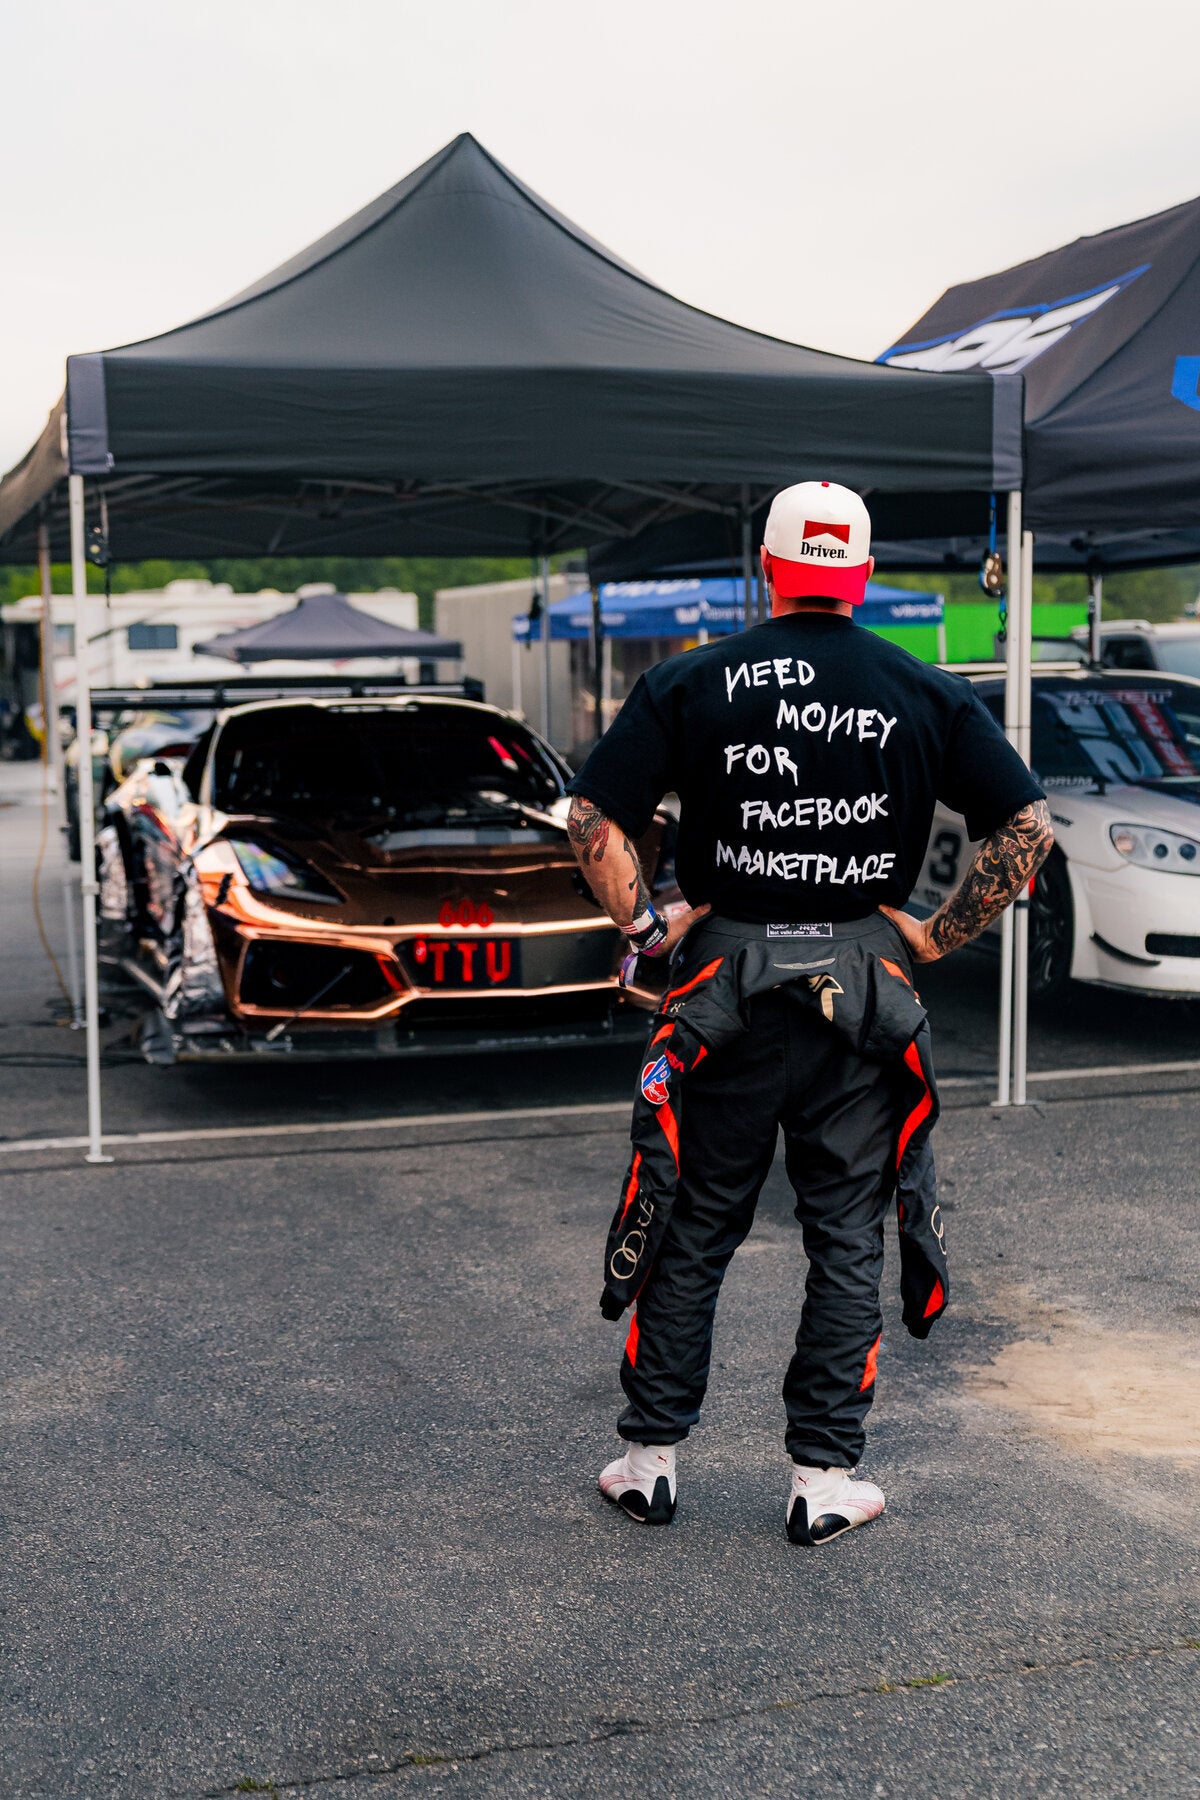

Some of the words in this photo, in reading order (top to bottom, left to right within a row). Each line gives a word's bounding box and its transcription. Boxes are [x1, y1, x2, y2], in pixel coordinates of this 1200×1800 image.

[800, 541, 848, 559] Driven.
[725, 657, 816, 703] NEED
[776, 699, 898, 749] MONEY
[724, 743, 798, 786] FOR
[740, 792, 888, 831] FACEBOOK
[716, 839, 896, 885] MARKETPLACE
[438, 899, 494, 928] 606
[428, 941, 511, 982] TTU
